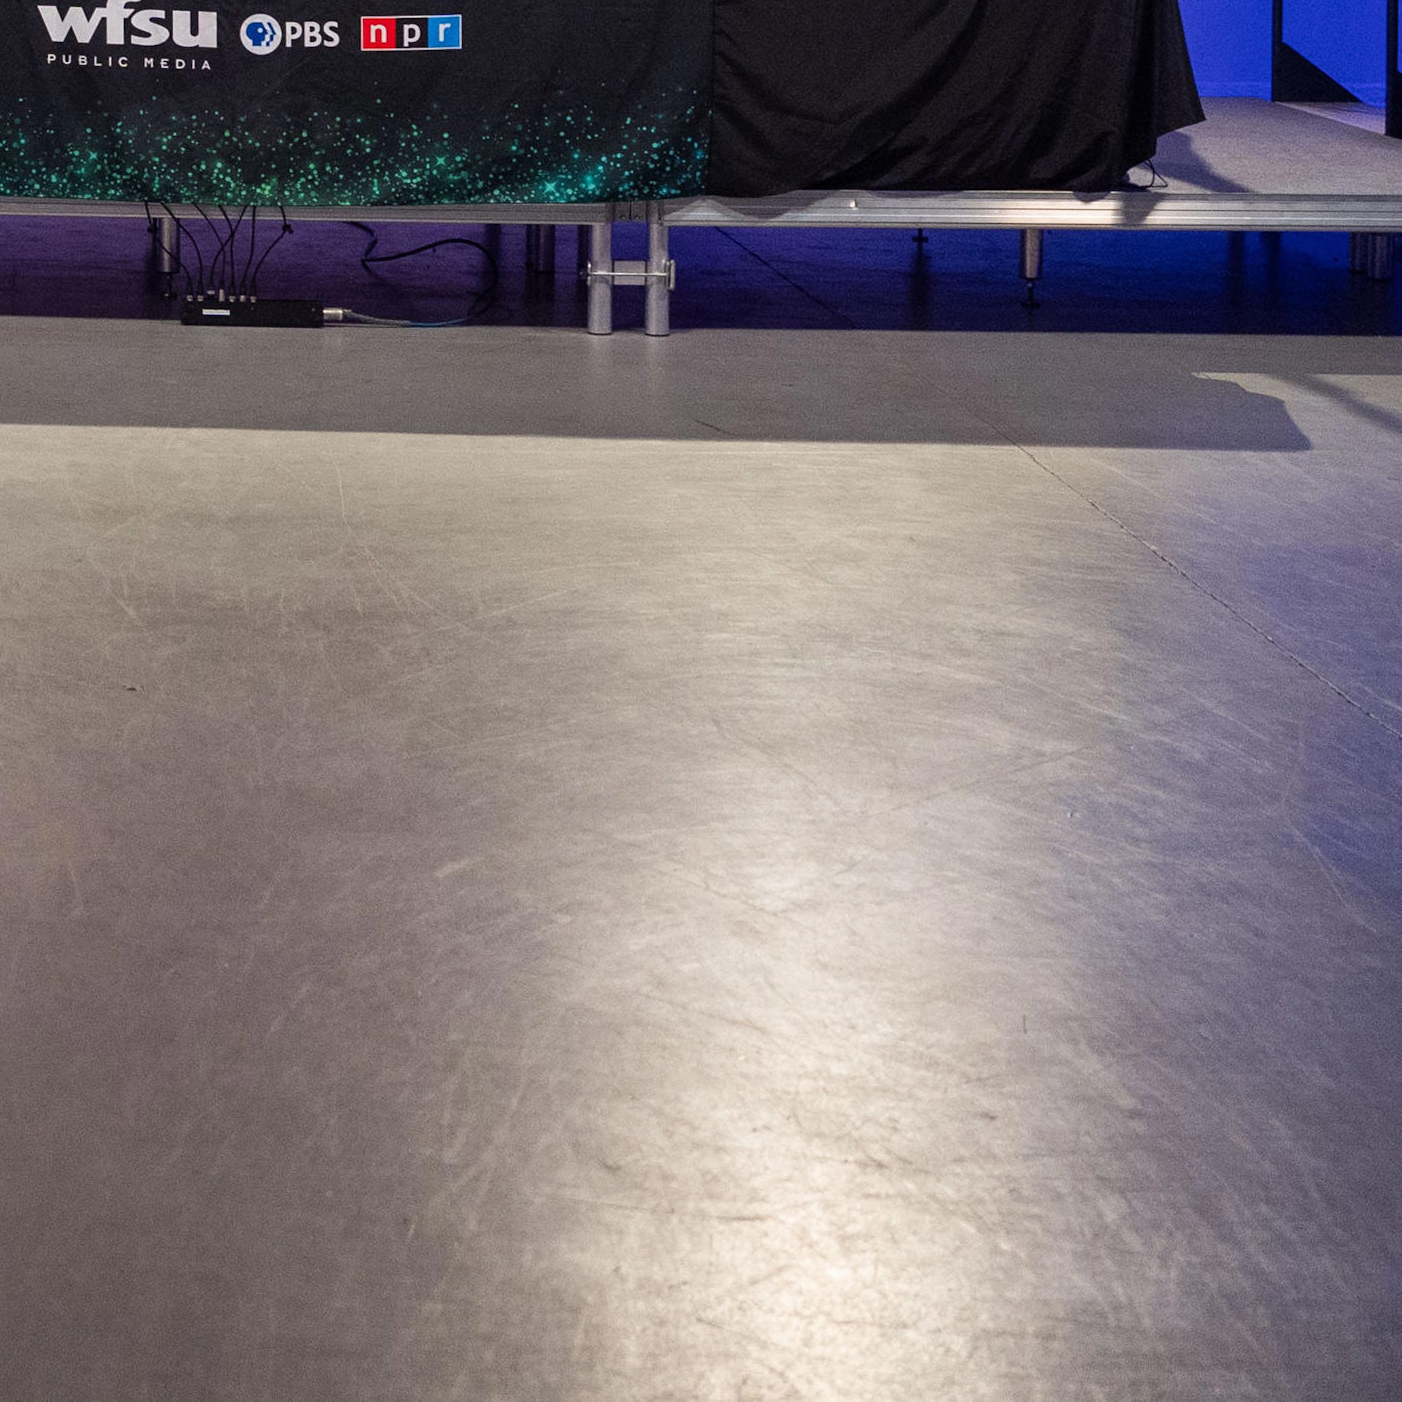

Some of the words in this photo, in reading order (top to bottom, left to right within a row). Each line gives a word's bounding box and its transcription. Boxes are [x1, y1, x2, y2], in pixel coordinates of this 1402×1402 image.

[285, 20, 341, 48] PBS
[369, 21, 452, 47] npr
[47, 53, 129, 68] PUBLIC
[144, 57, 212, 71] MEDIA
